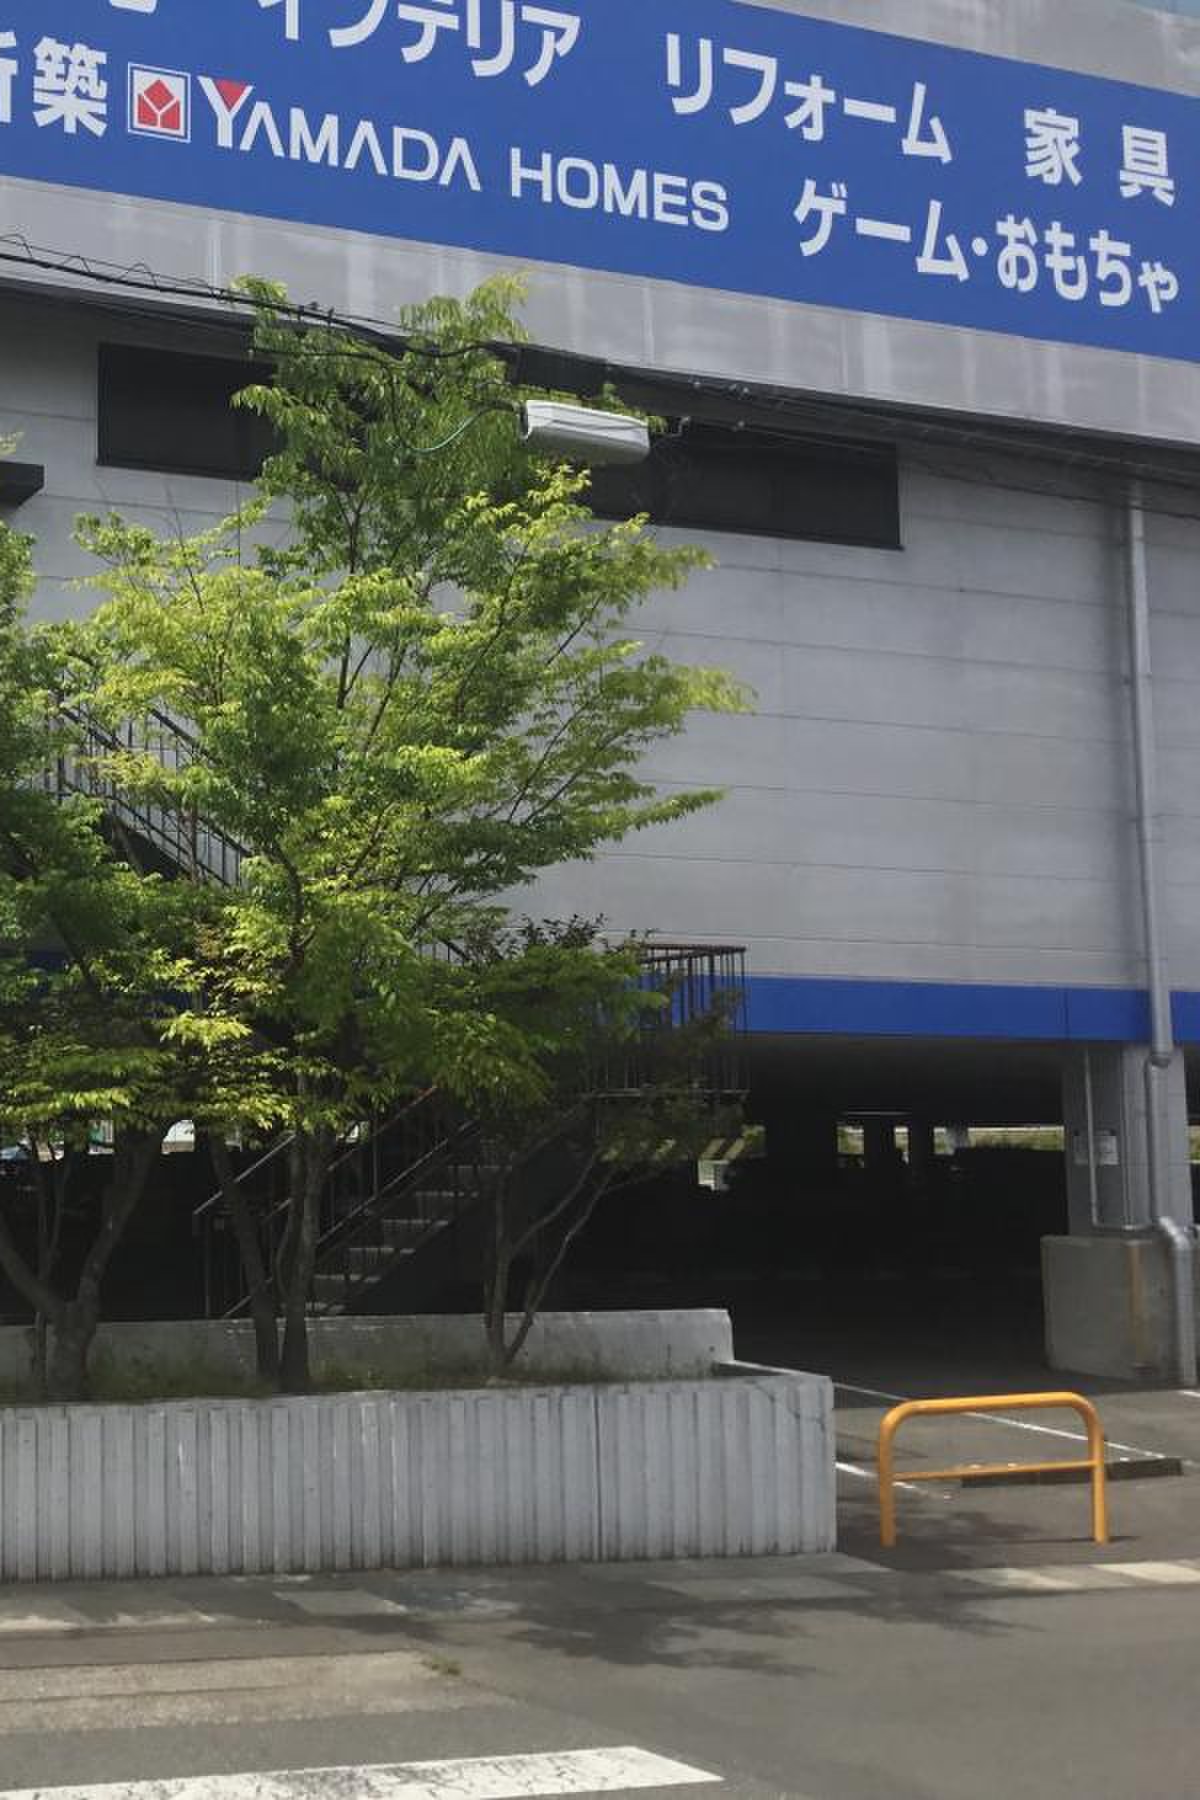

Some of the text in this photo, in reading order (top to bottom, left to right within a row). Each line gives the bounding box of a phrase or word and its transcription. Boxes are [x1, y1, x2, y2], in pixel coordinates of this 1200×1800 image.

[198, 75, 482, 192] YAMADA
[510, 147, 729, 232] HOMES
[666, 32, 954, 164] リフォーム
[1023, 107, 1175, 207] 家具
